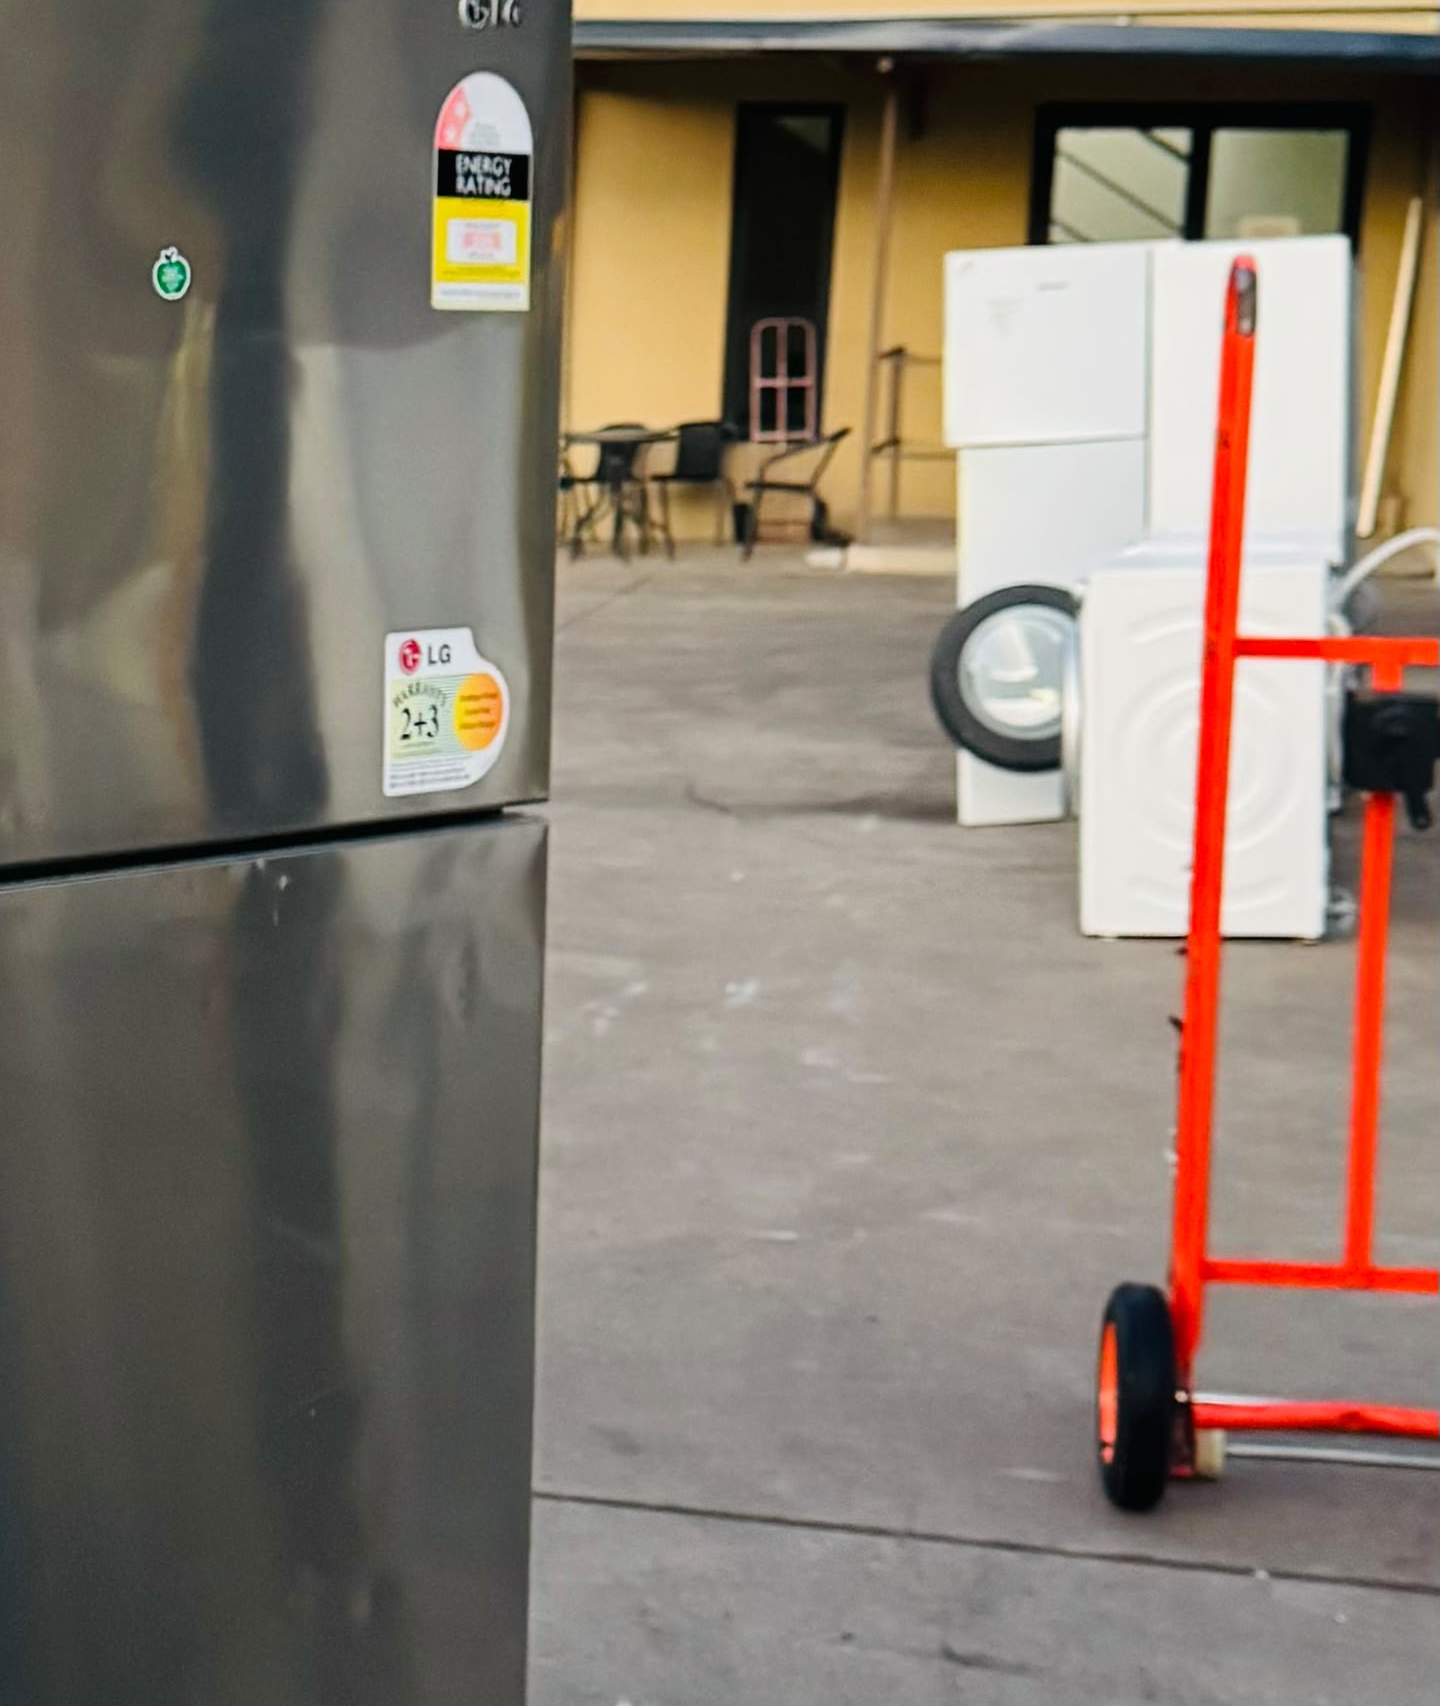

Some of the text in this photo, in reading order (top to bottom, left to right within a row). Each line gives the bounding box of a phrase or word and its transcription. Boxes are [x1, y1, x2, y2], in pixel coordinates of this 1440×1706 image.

[455, 153, 512, 177] ENERGY
[455, 175, 512, 197] RATING
[428, 644, 451, 665] LG
[400, 704, 439, 740] 2+3
